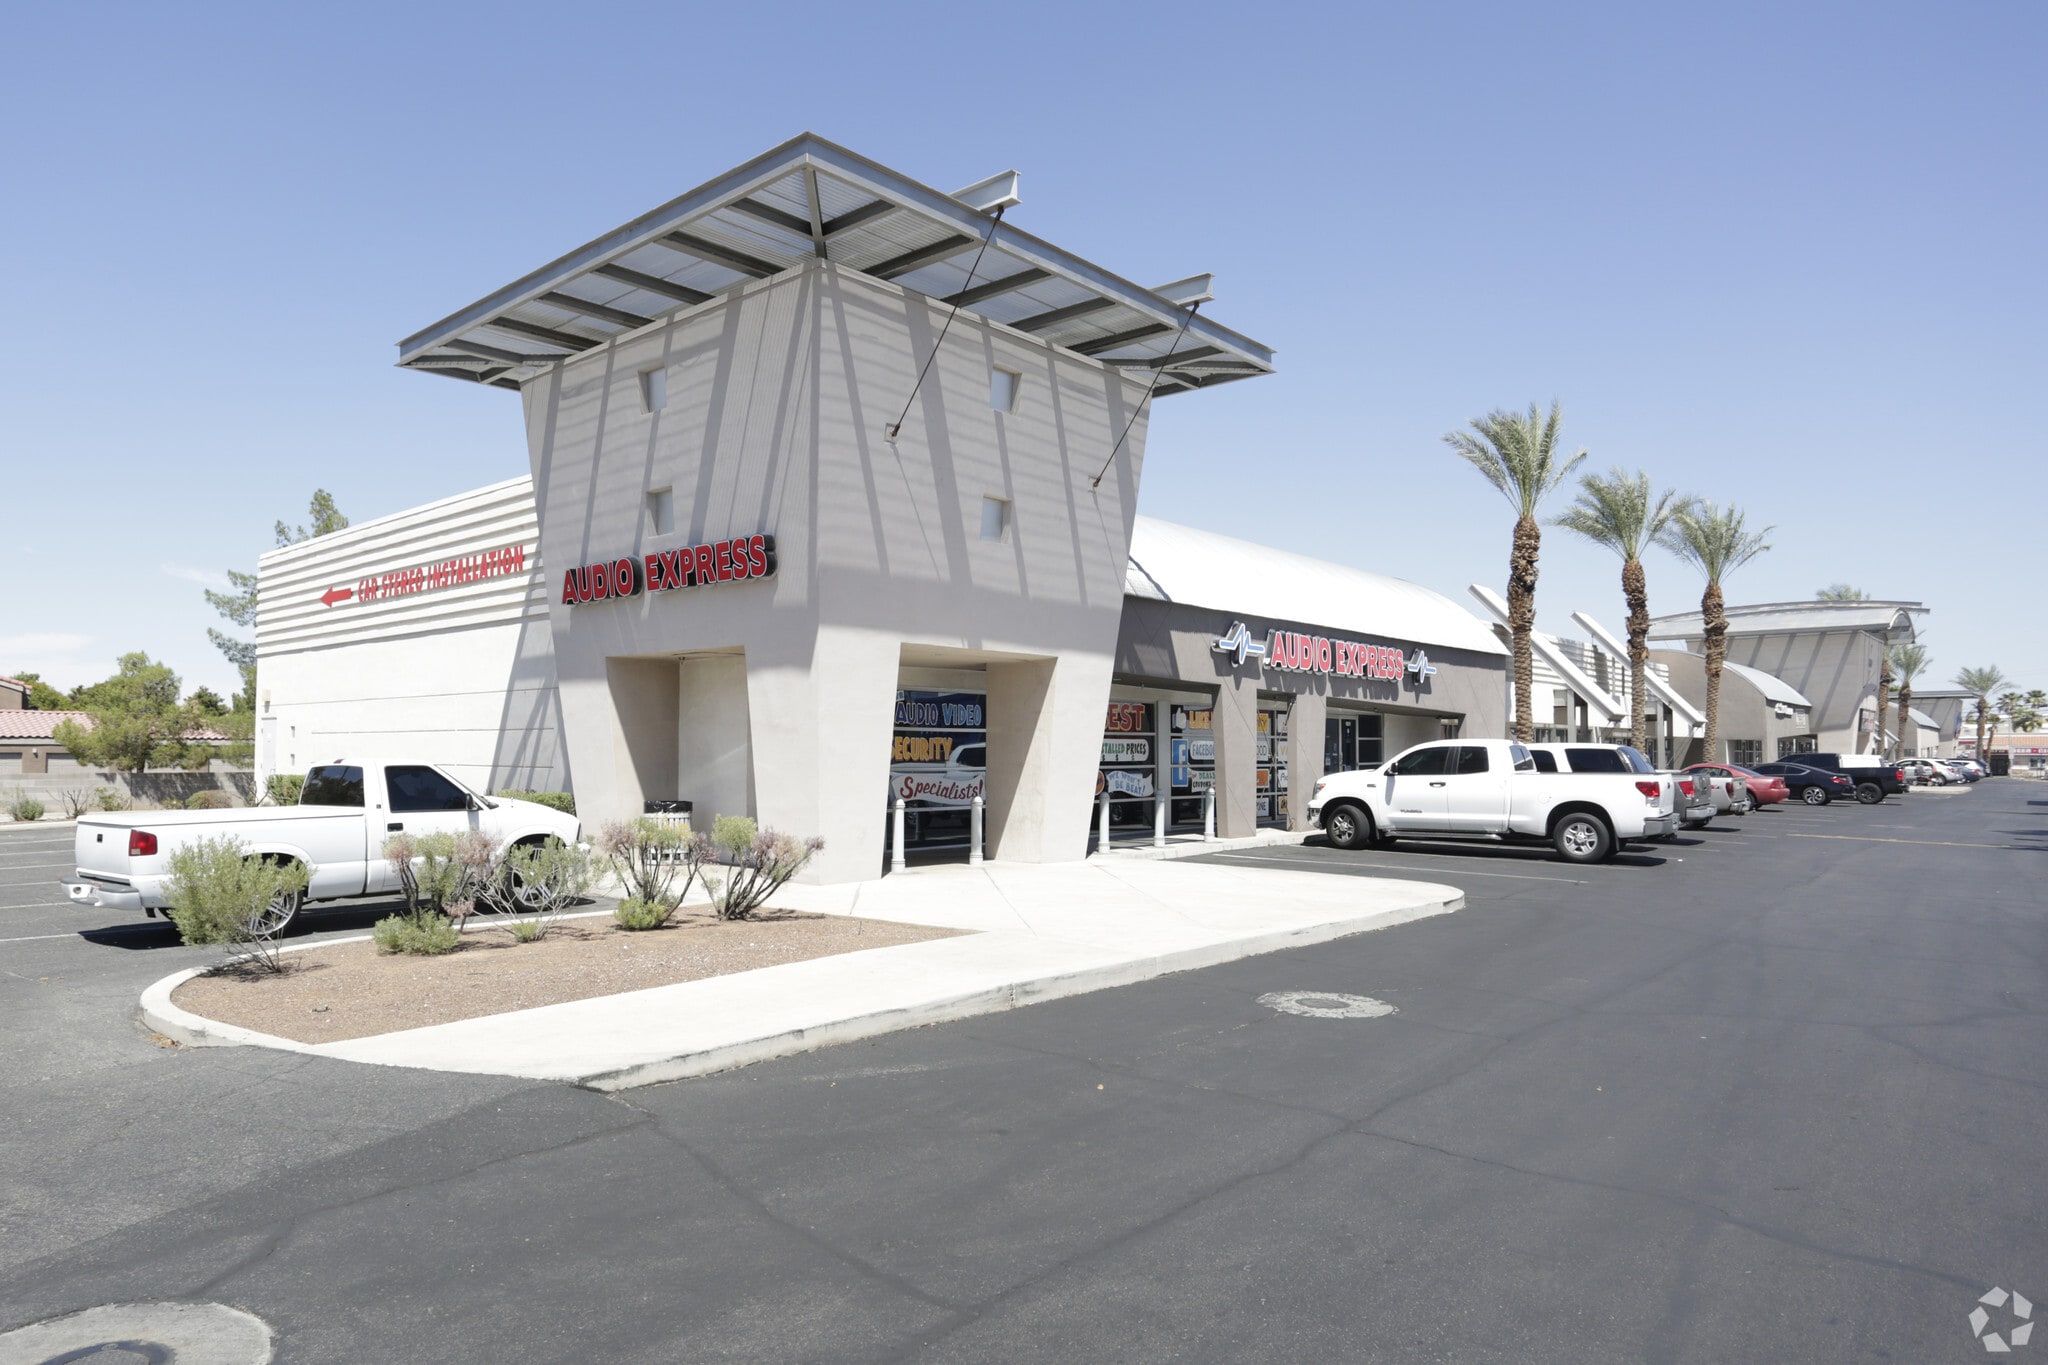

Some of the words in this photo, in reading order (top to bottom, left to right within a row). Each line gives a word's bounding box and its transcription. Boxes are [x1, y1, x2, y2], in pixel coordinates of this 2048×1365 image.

[357, 577, 378, 603] CAR
[381, 567, 424, 599] STEREO
[427, 544, 525, 590] INSTALLATION
[562, 557, 635, 605] AUDIO
[644, 534, 768, 592] EXPRESS
[1271, 631, 1332, 673] AUDIO
[1335, 640, 1404, 681] EXPRESS
[894, 701, 939, 726] AUDIO
[941, 702, 982, 726] VIDEO
[1105, 703, 1146, 732] EST
[1125, 742, 1147, 756] PRICES
[900, 775, 984, 800] Specialists!
